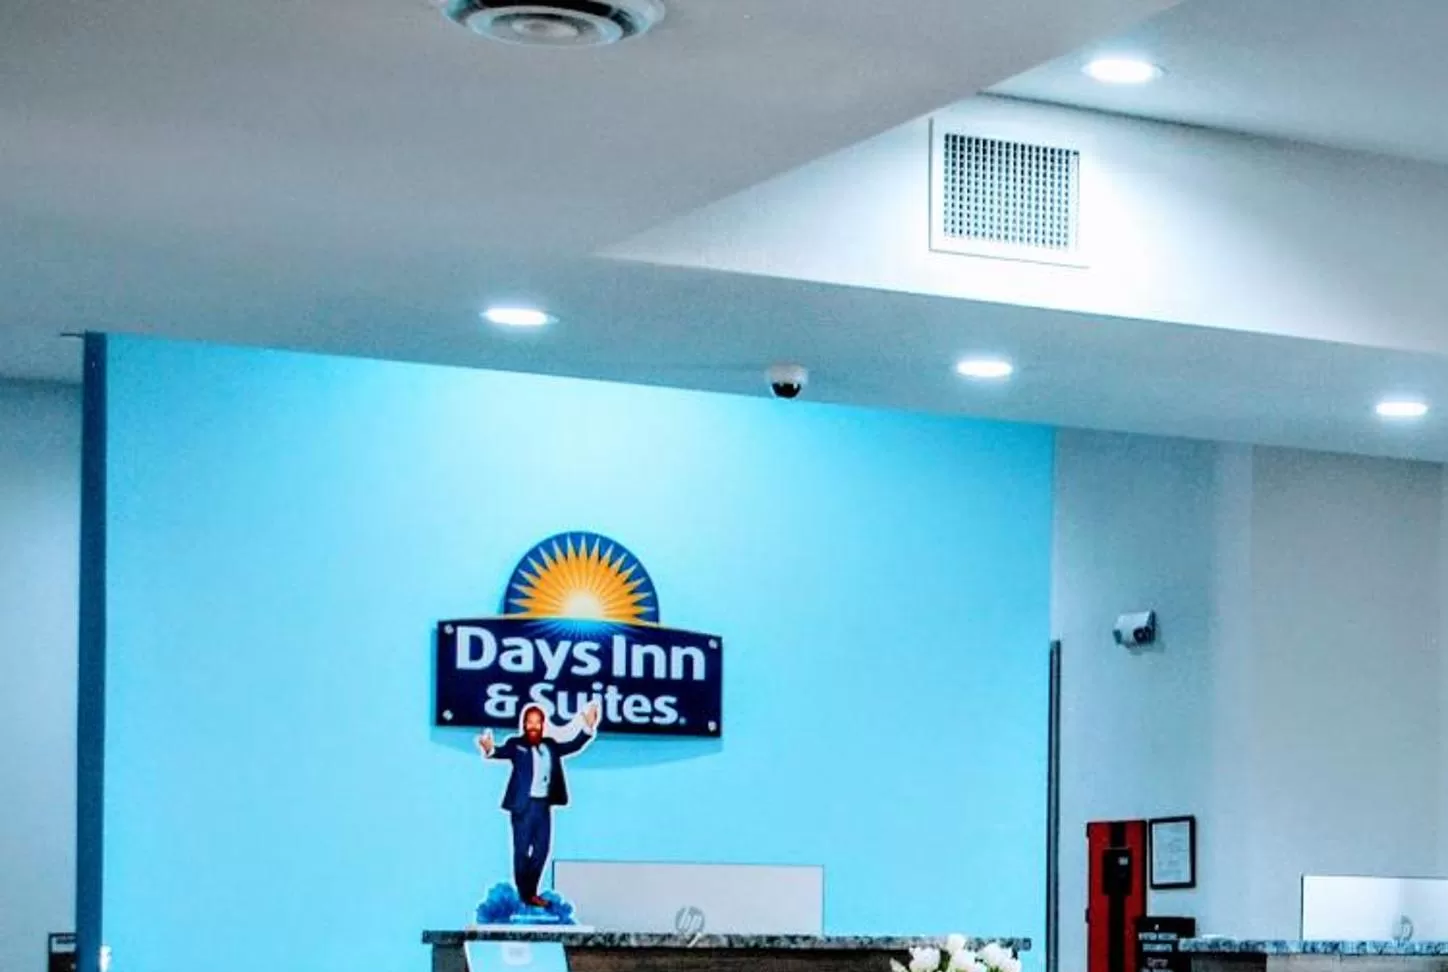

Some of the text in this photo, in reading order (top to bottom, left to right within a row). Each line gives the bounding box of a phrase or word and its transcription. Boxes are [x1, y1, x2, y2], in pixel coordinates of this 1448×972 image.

[455, 626, 706, 680] Days Inn
[484, 683, 519, 718] &
